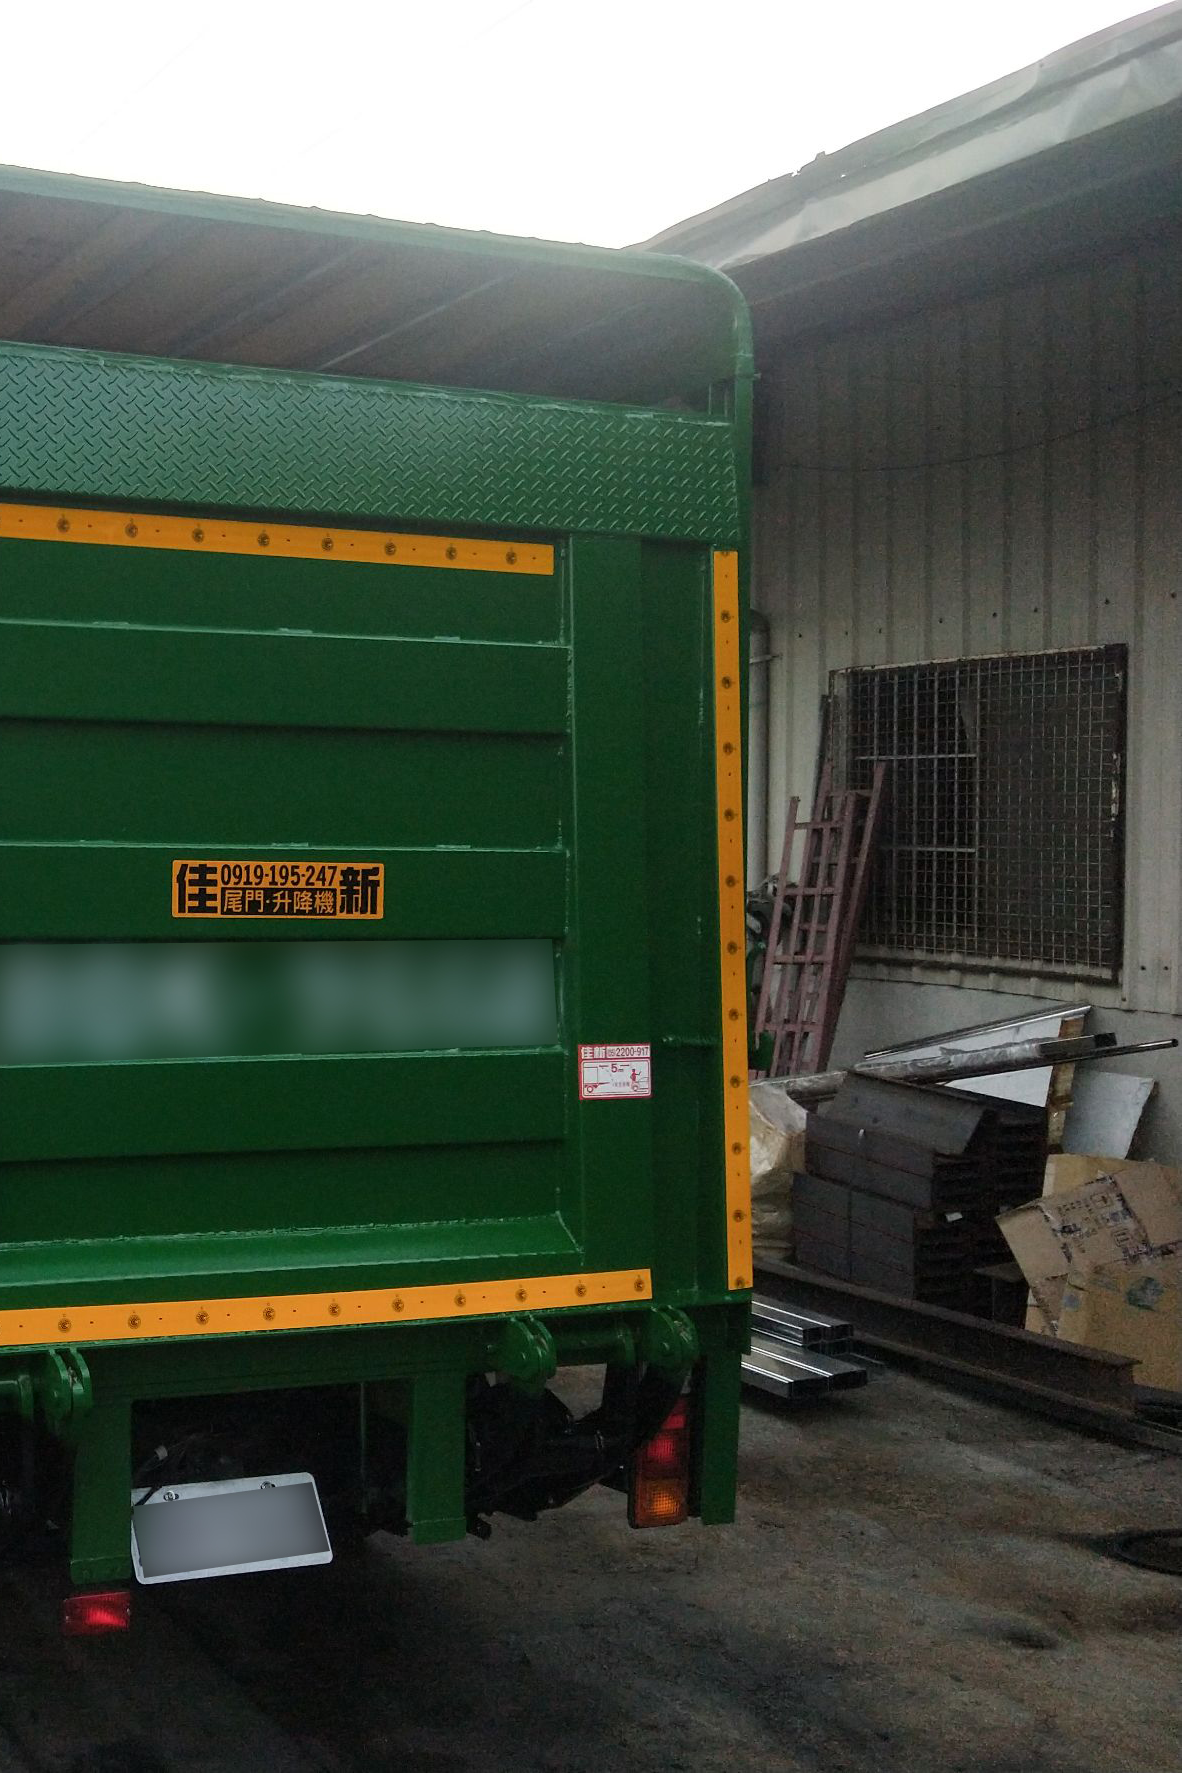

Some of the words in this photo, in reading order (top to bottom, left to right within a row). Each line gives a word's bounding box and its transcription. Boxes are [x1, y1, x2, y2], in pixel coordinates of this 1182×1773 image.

[176, 863, 218, 914] 佳
[220, 864, 338, 887] 0919-195-247
[339, 866, 380, 915] 新
